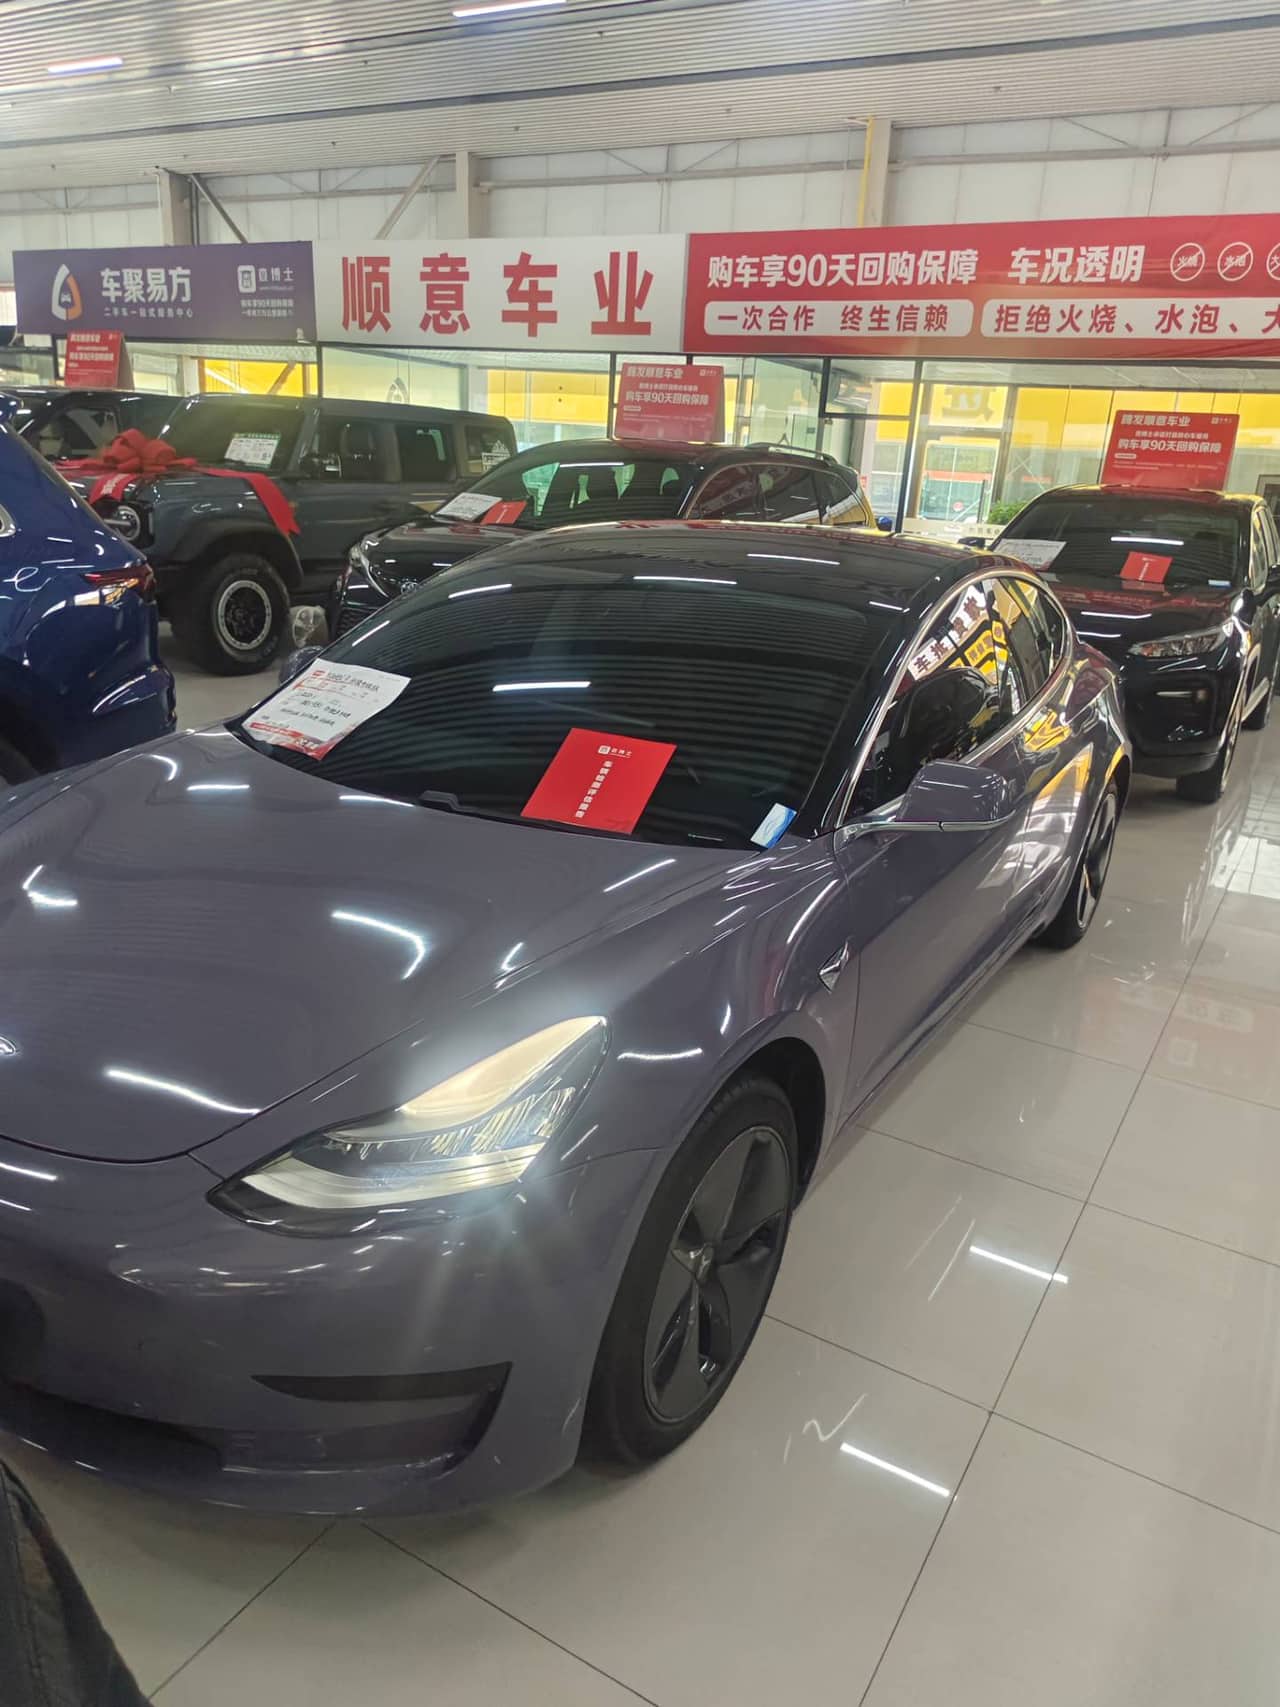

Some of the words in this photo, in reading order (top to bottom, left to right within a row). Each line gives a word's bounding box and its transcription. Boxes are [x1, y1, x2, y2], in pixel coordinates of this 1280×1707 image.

[100, 266, 192, 303] 车聚易方
[707, 248, 979, 288] 购车享90天回购保障
[1008, 245, 1146, 284] 车况透明
[341, 251, 654, 338] 顺意车业
[717, 304, 816, 332] 一次合作
[840, 304, 948, 333] 终生信赖
